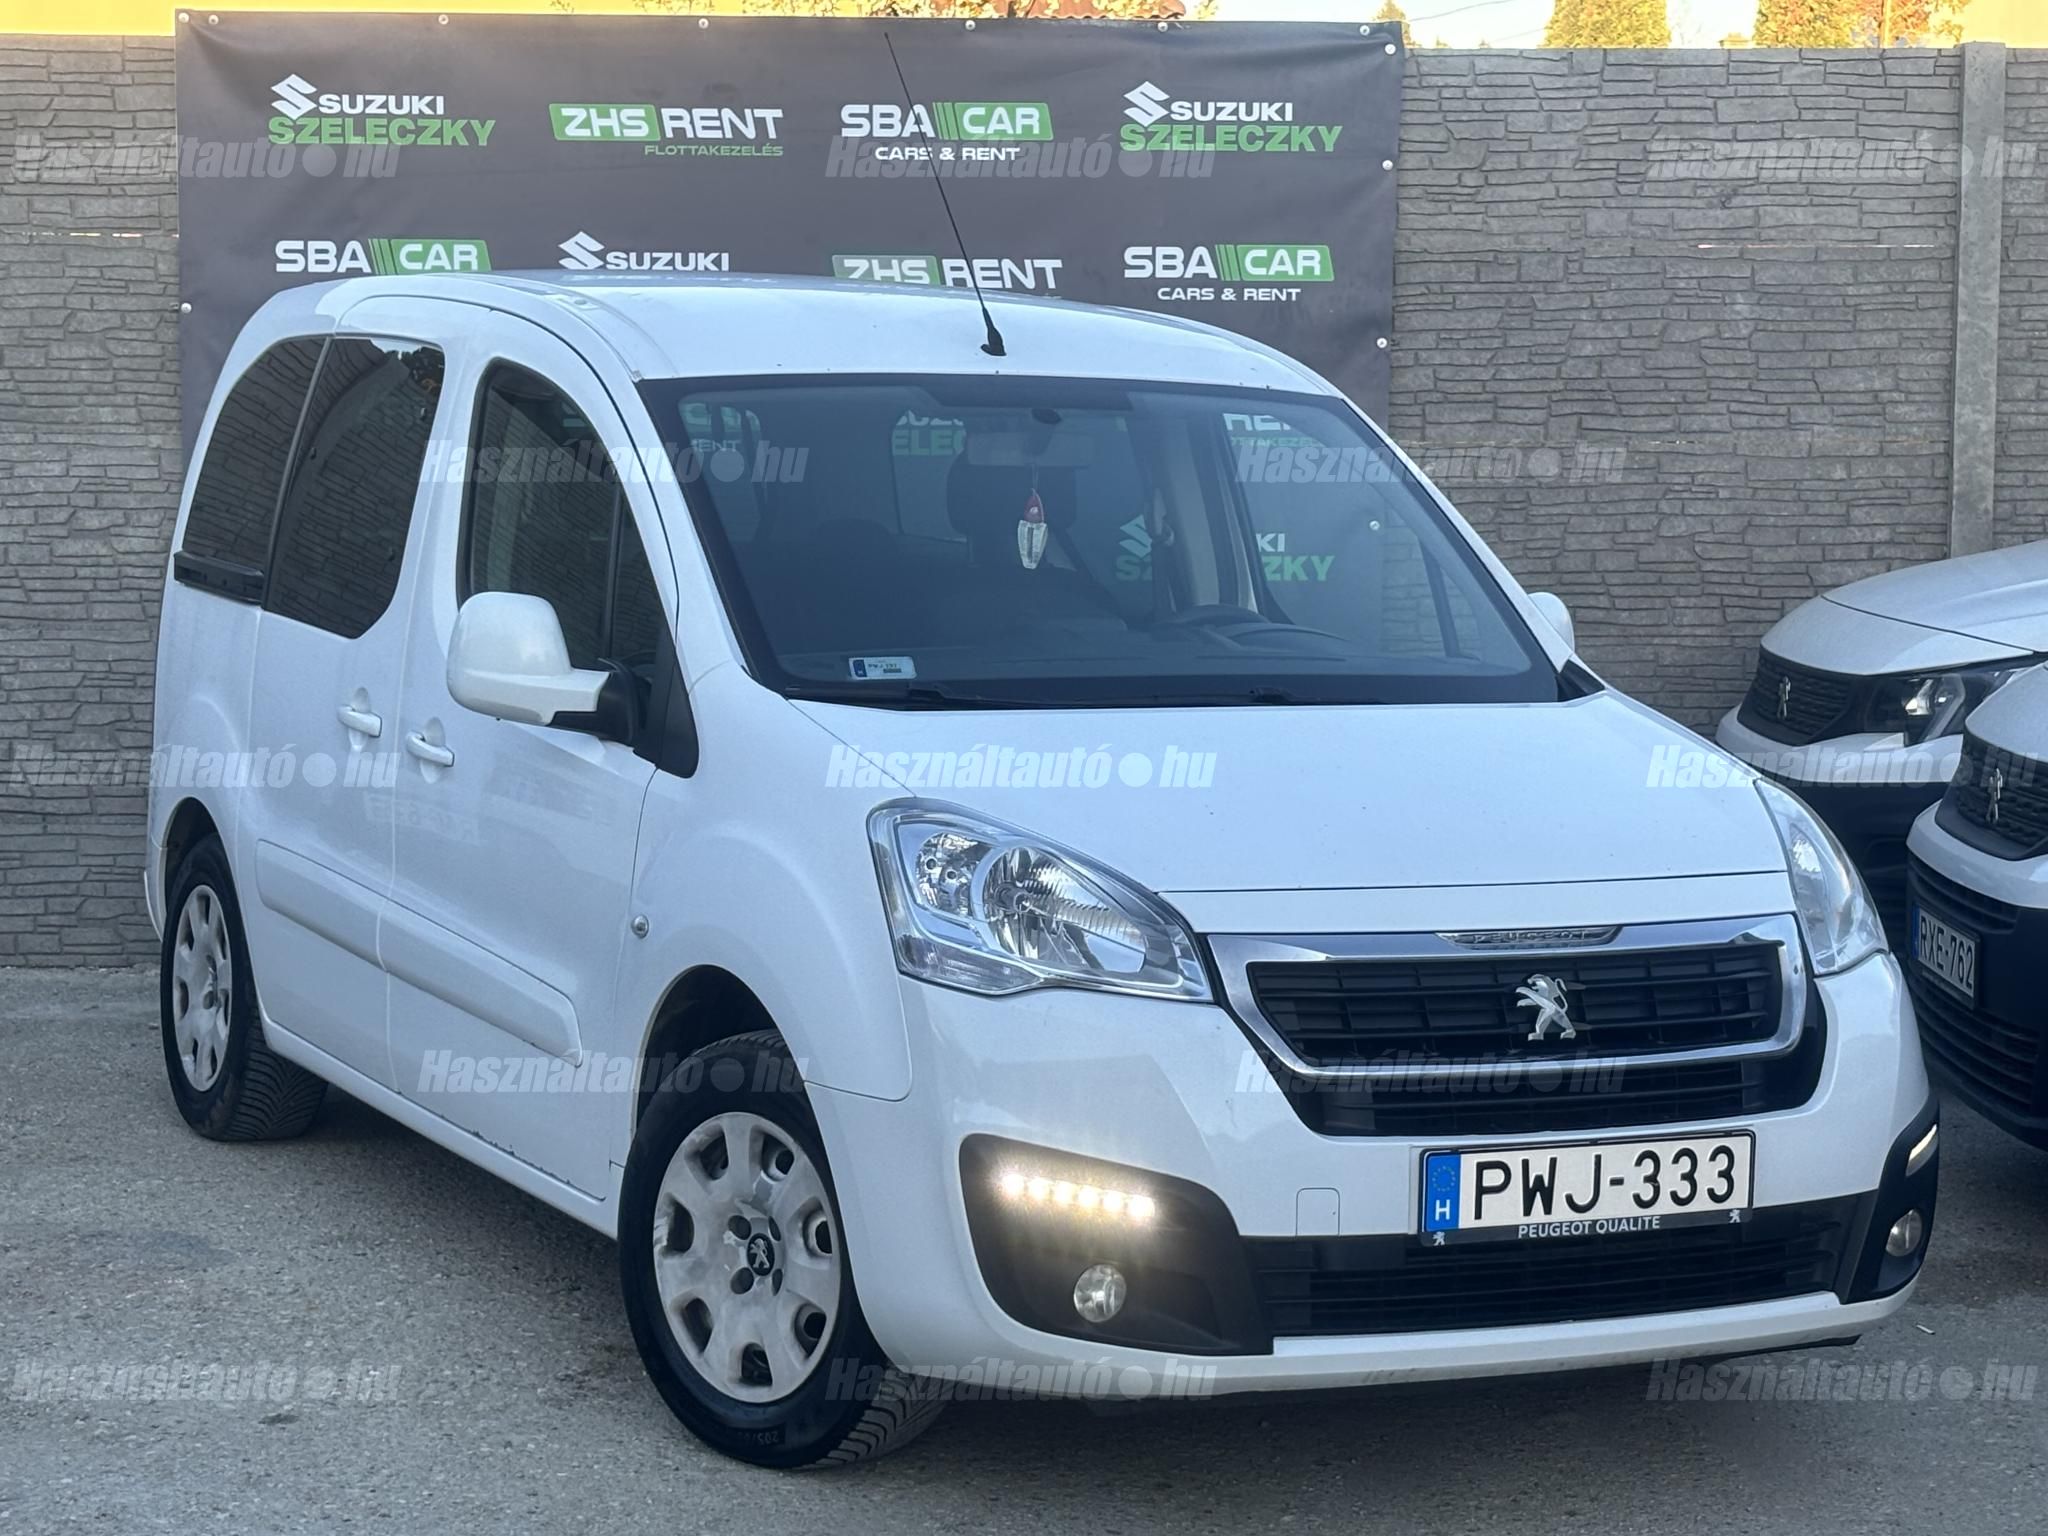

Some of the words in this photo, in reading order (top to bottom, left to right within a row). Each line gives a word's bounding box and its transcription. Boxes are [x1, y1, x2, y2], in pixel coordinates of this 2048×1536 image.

[318, 94, 444, 115] SUZUKI
[1170, 101, 1293, 122] SUZUKI
[268, 116, 496, 146] SZELECZKY
[560, 107, 649, 138] ZHS
[663, 107, 783, 140] RENT
[840, 103, 936, 138] SBA
[961, 106, 1040, 136] CAR
[644, 142, 783, 157] FLOTTAKEZELÉS
[1120, 124, 1343, 153] SZELECZKY
[875, 146, 933, 161] CARS
[939, 147, 955, 160] &
[962, 147, 1020, 161] RENT
[275, 239, 372, 273] SBA
[399, 243, 479, 271] CAR
[605, 251, 730, 272] SUZUKI
[1123, 246, 1220, 280] SBA
[1242, 248, 1322, 277] CAR
[942, 258, 1063, 290] RENT
[1157, 287, 1215, 301] CARS
[1221, 287, 1236, 301] &
[1243, 288, 1301, 302] RENT
[1920, 915, 1974, 990] RXE-762
[1434, 1199, 1451, 1222] H
[1473, 1144, 1736, 1221] PWJ-333
[1517, 1221, 1593, 1239] PEUGEOT
[1595, 1216, 1661, 1235] QUALITE
